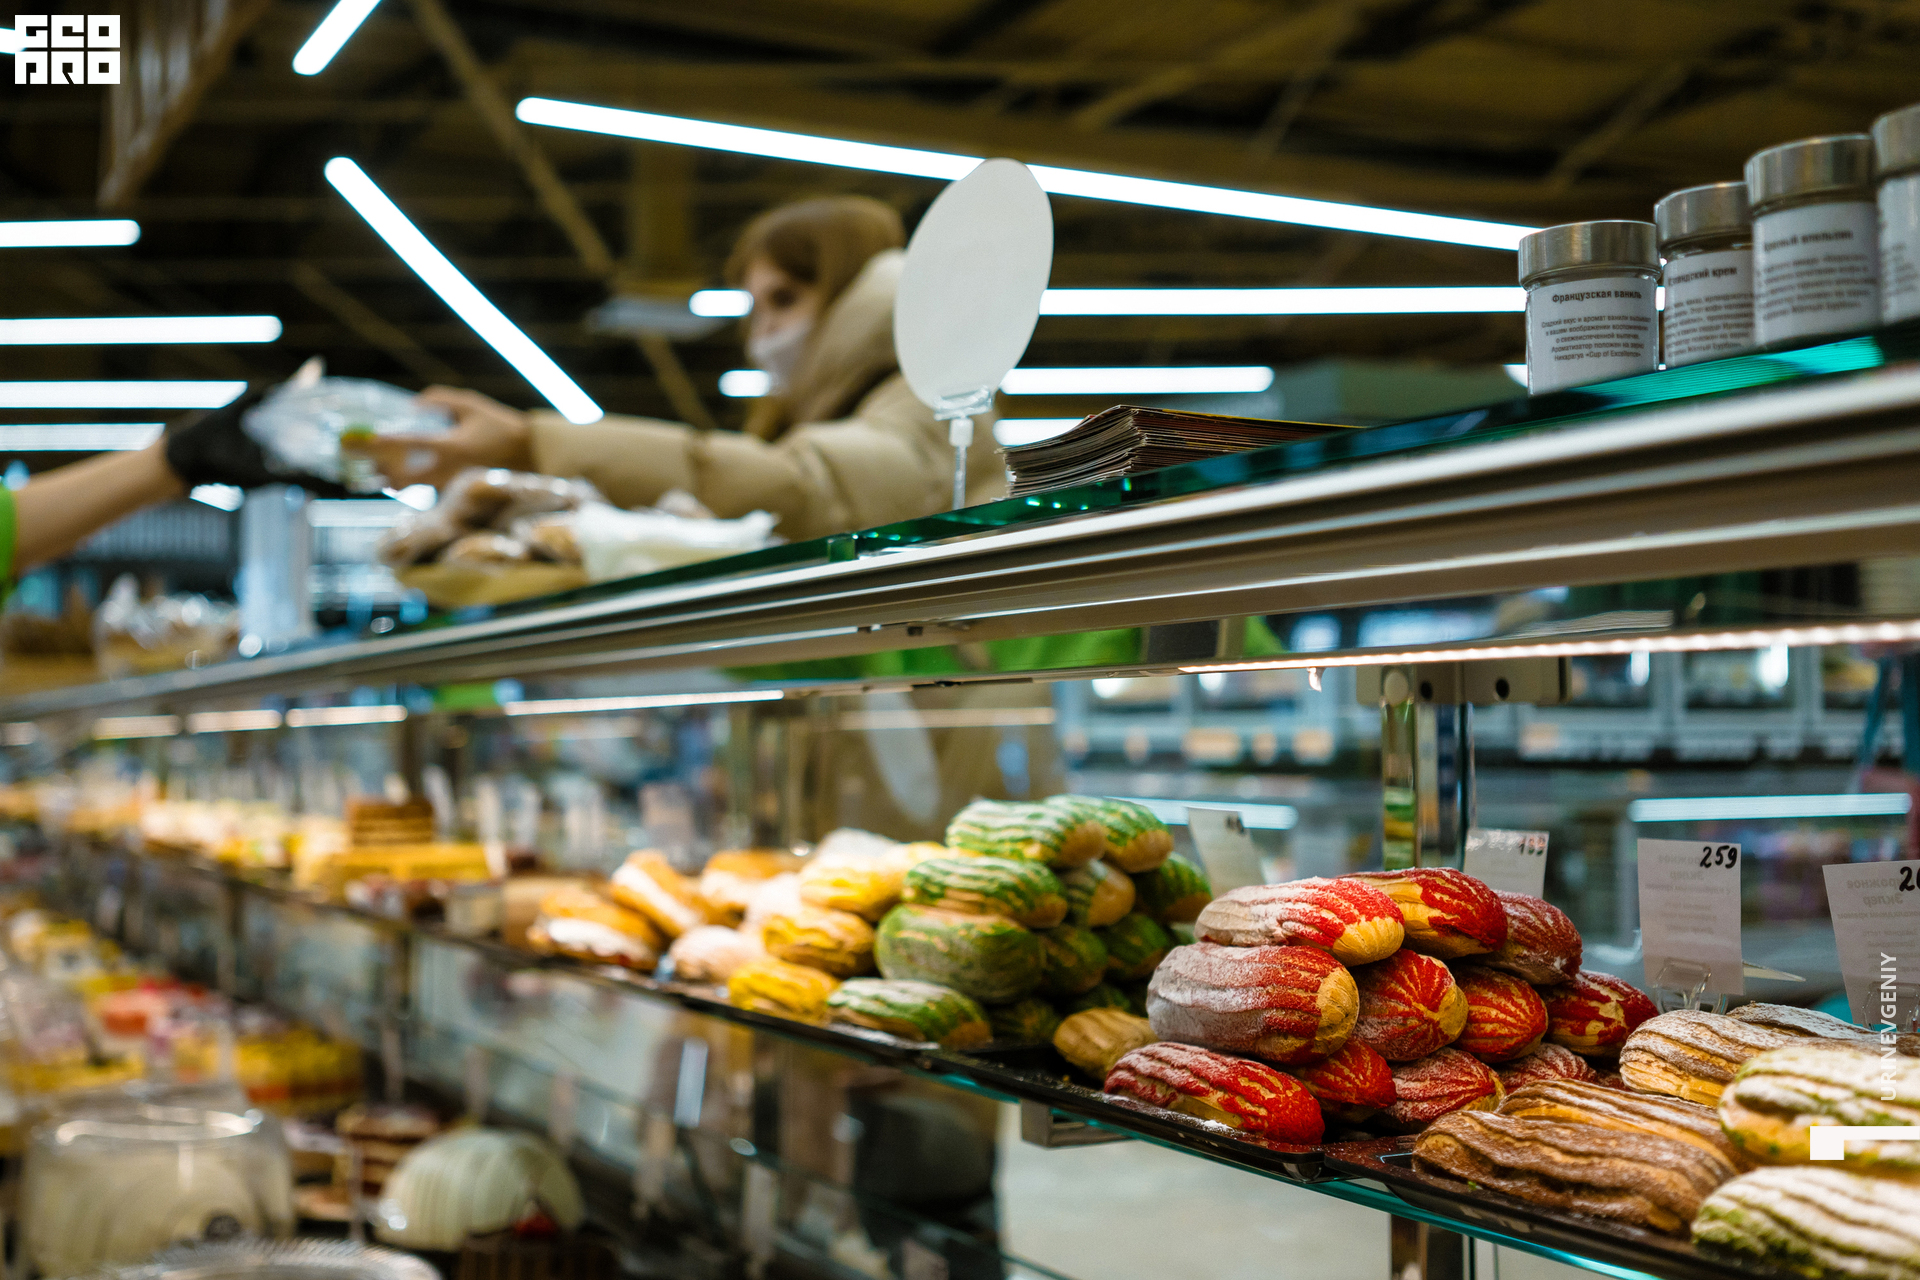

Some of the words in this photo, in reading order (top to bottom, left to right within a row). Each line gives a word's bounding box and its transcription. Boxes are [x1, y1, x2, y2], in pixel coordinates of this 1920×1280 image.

[1712, 267, 1738, 279] крем
[1552, 290, 1611, 304] Французская
[1614, 290, 1642, 299] ваниль
[1583, 315, 1606, 323] аромат
[1551, 343, 1593, 353] Ароматизатор
[1554, 352, 1584, 361] Никарагуа
[1700, 845, 1738, 869] 259
